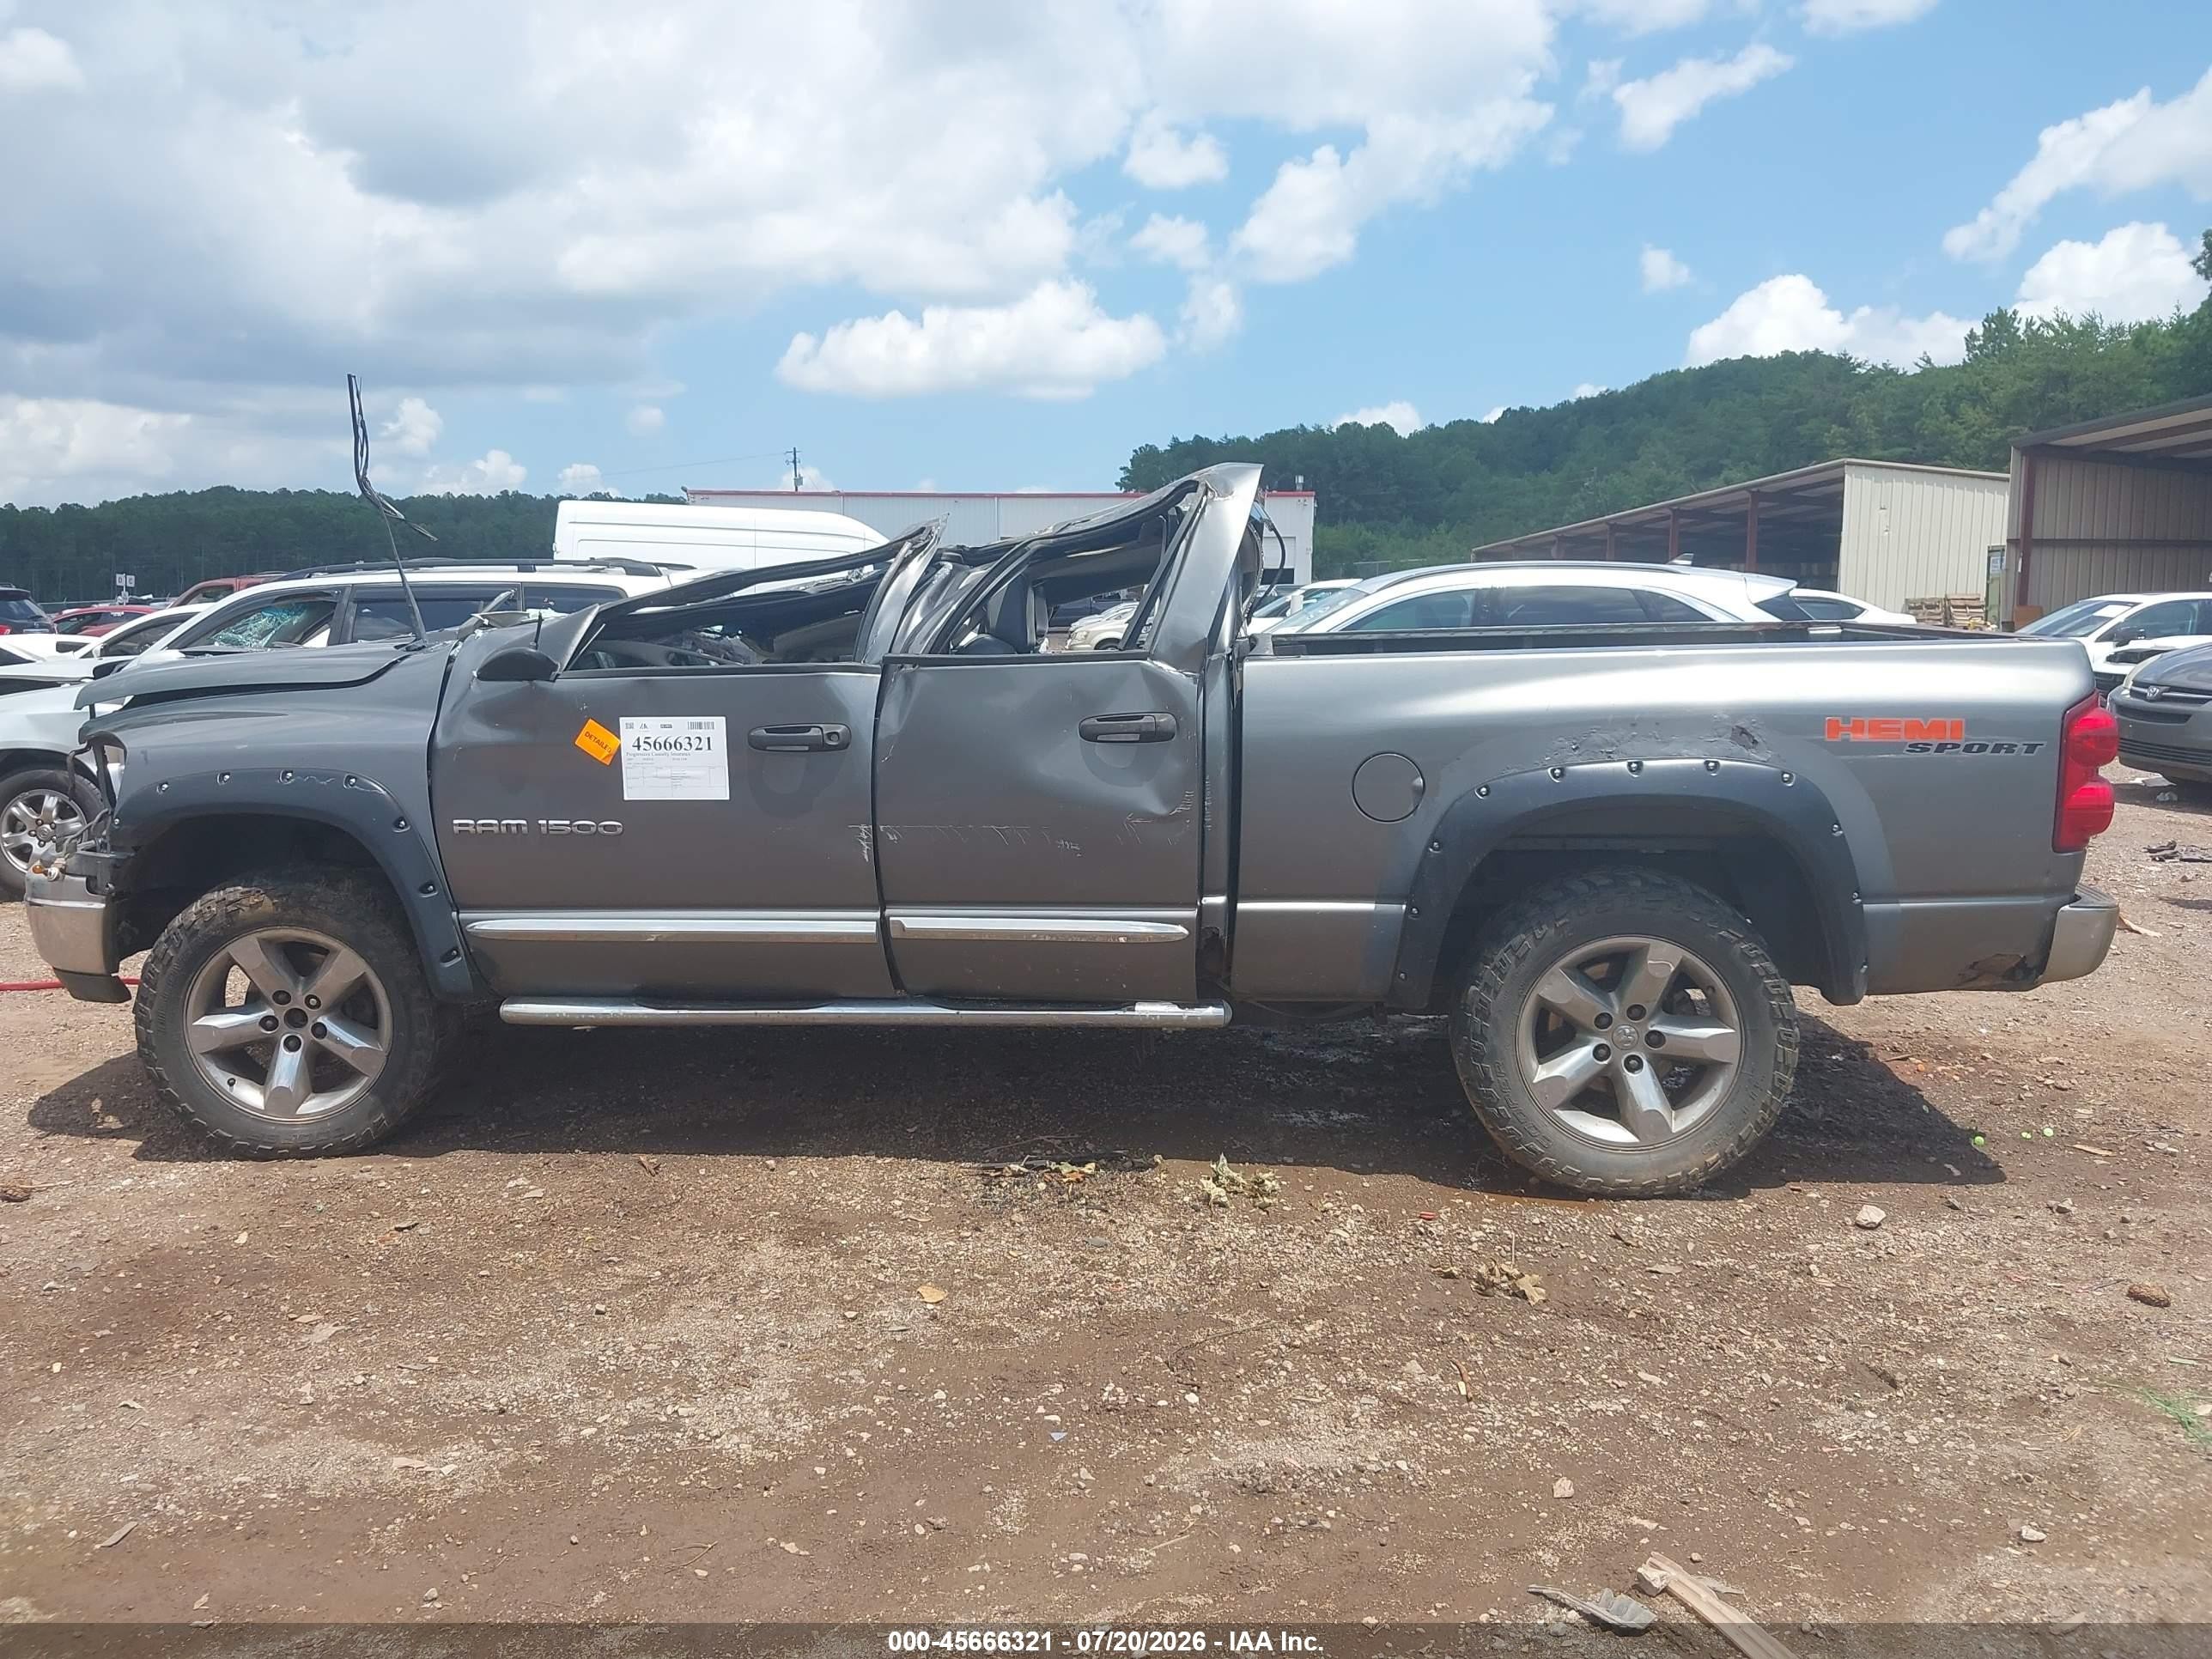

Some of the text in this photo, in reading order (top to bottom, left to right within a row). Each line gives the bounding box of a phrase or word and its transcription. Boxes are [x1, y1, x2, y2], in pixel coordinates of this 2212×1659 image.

[1826, 717, 1965, 741] HEMI
[584, 731, 612, 753] DETAILED
[632, 736, 714, 751] 45666321
[1905, 742, 2046, 756] SPORT
[453, 819, 623, 836] RAM 1500
